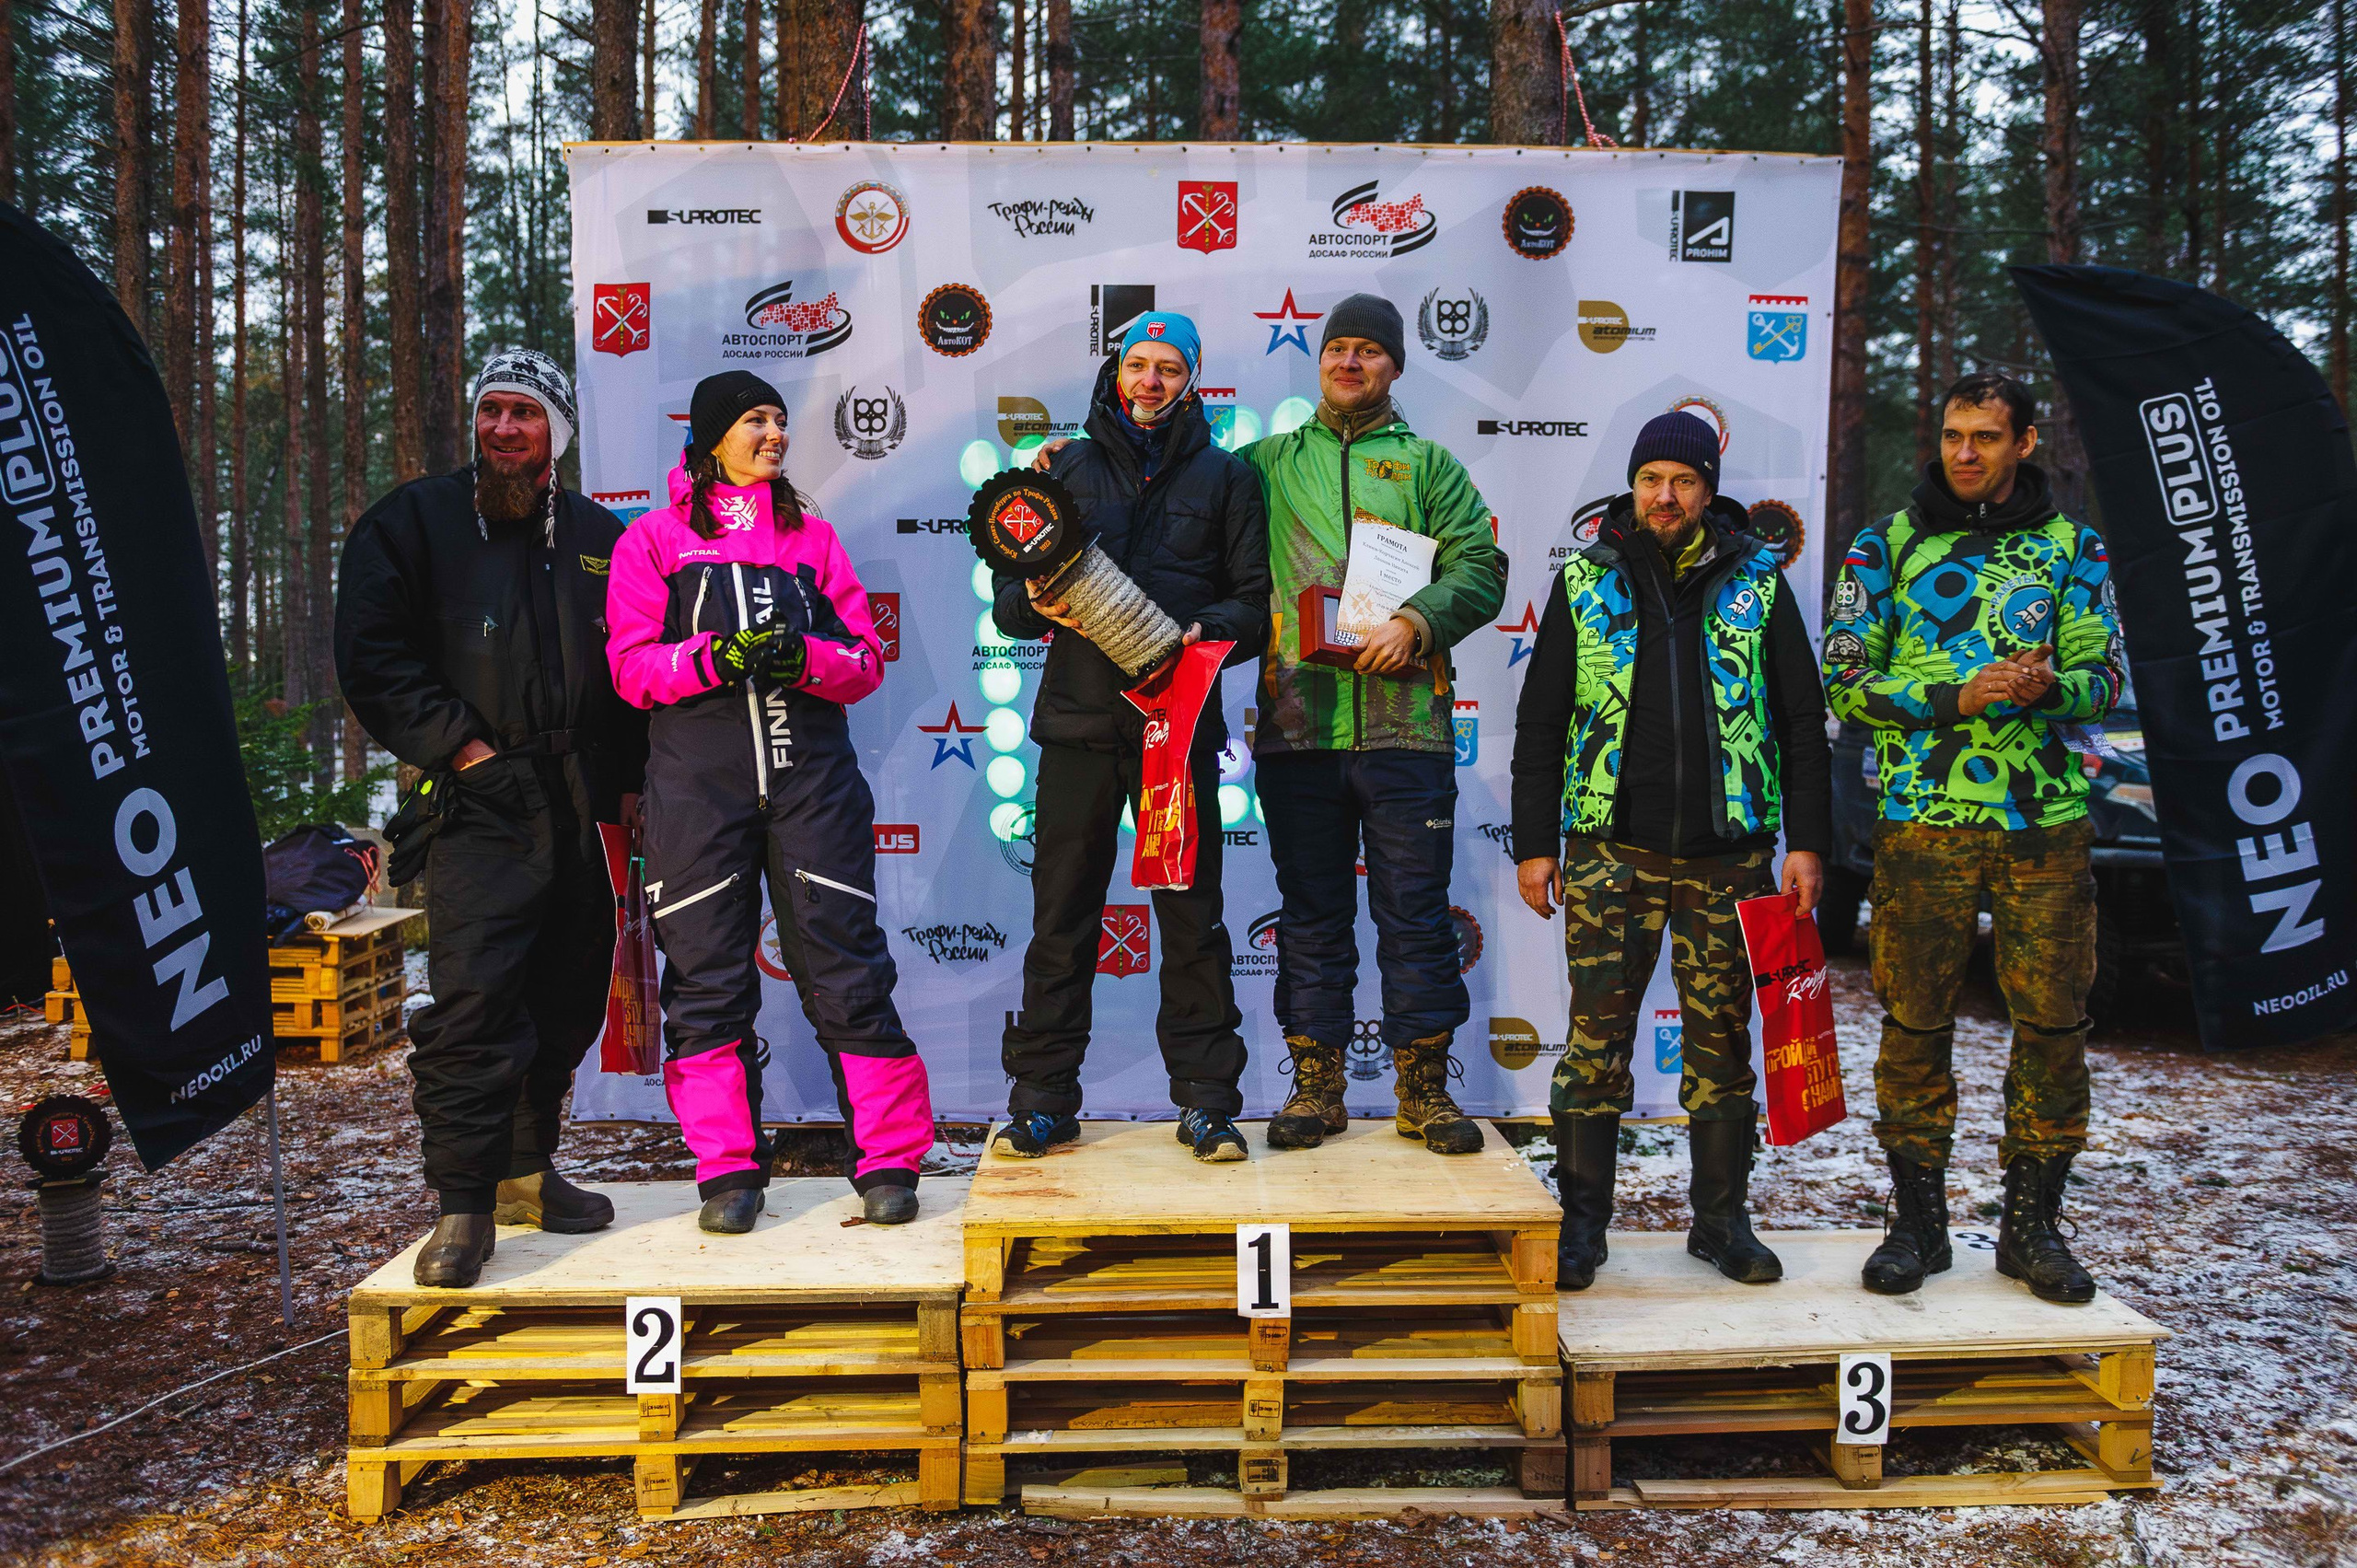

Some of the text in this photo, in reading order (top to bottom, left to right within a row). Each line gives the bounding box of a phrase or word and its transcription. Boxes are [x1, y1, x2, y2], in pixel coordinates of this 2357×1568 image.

[667, 209, 761, 224] SUPROTEC
[1015, 215, 1075, 238] России
[1308, 234, 1388, 245] АВТОСПОРТ
[1308, 250, 1388, 258] ДОСААФ РОССИИ
[1685, 248, 1728, 258] PROHIM
[722, 334, 804, 346] АВТОСПОРТ
[1090, 305, 1099, 356] SUPROTEC
[1593, 326, 1656, 336] atomium
[722, 350, 804, 359] ДОСААФ РОССИИ
[1013, 422, 1079, 431] atomium
[1495, 420, 1588, 436] SUPROTEC
[13, 313, 151, 760] MOTOR & TRANSMISSION OIL
[1376, 533, 1408, 552] ГРАМОТА
[2193, 377, 2285, 730] MOTOR & TRANSMISSION OIL
[2149, 402, 2251, 742] PREMIUM PLUS
[1990, 573, 2036, 606] РАКЕТЫ
[17, 505, 126, 781] PREMIUM
[971, 661, 1046, 670] ДОСААФ РОССИ
[2227, 752, 2325, 955] NEO
[114, 787, 230, 1033] NEO
[928, 938, 989, 964] России
[2253, 969, 2349, 1016] NEOOIL.RU
[1504, 1041, 1566, 1052] atomium
[170, 1035, 262, 1105] NEOOIL.RU
[1248, 1232, 1280, 1310] 1
[633, 1307, 676, 1384] 2
[1844, 1361, 1887, 1435] 3
